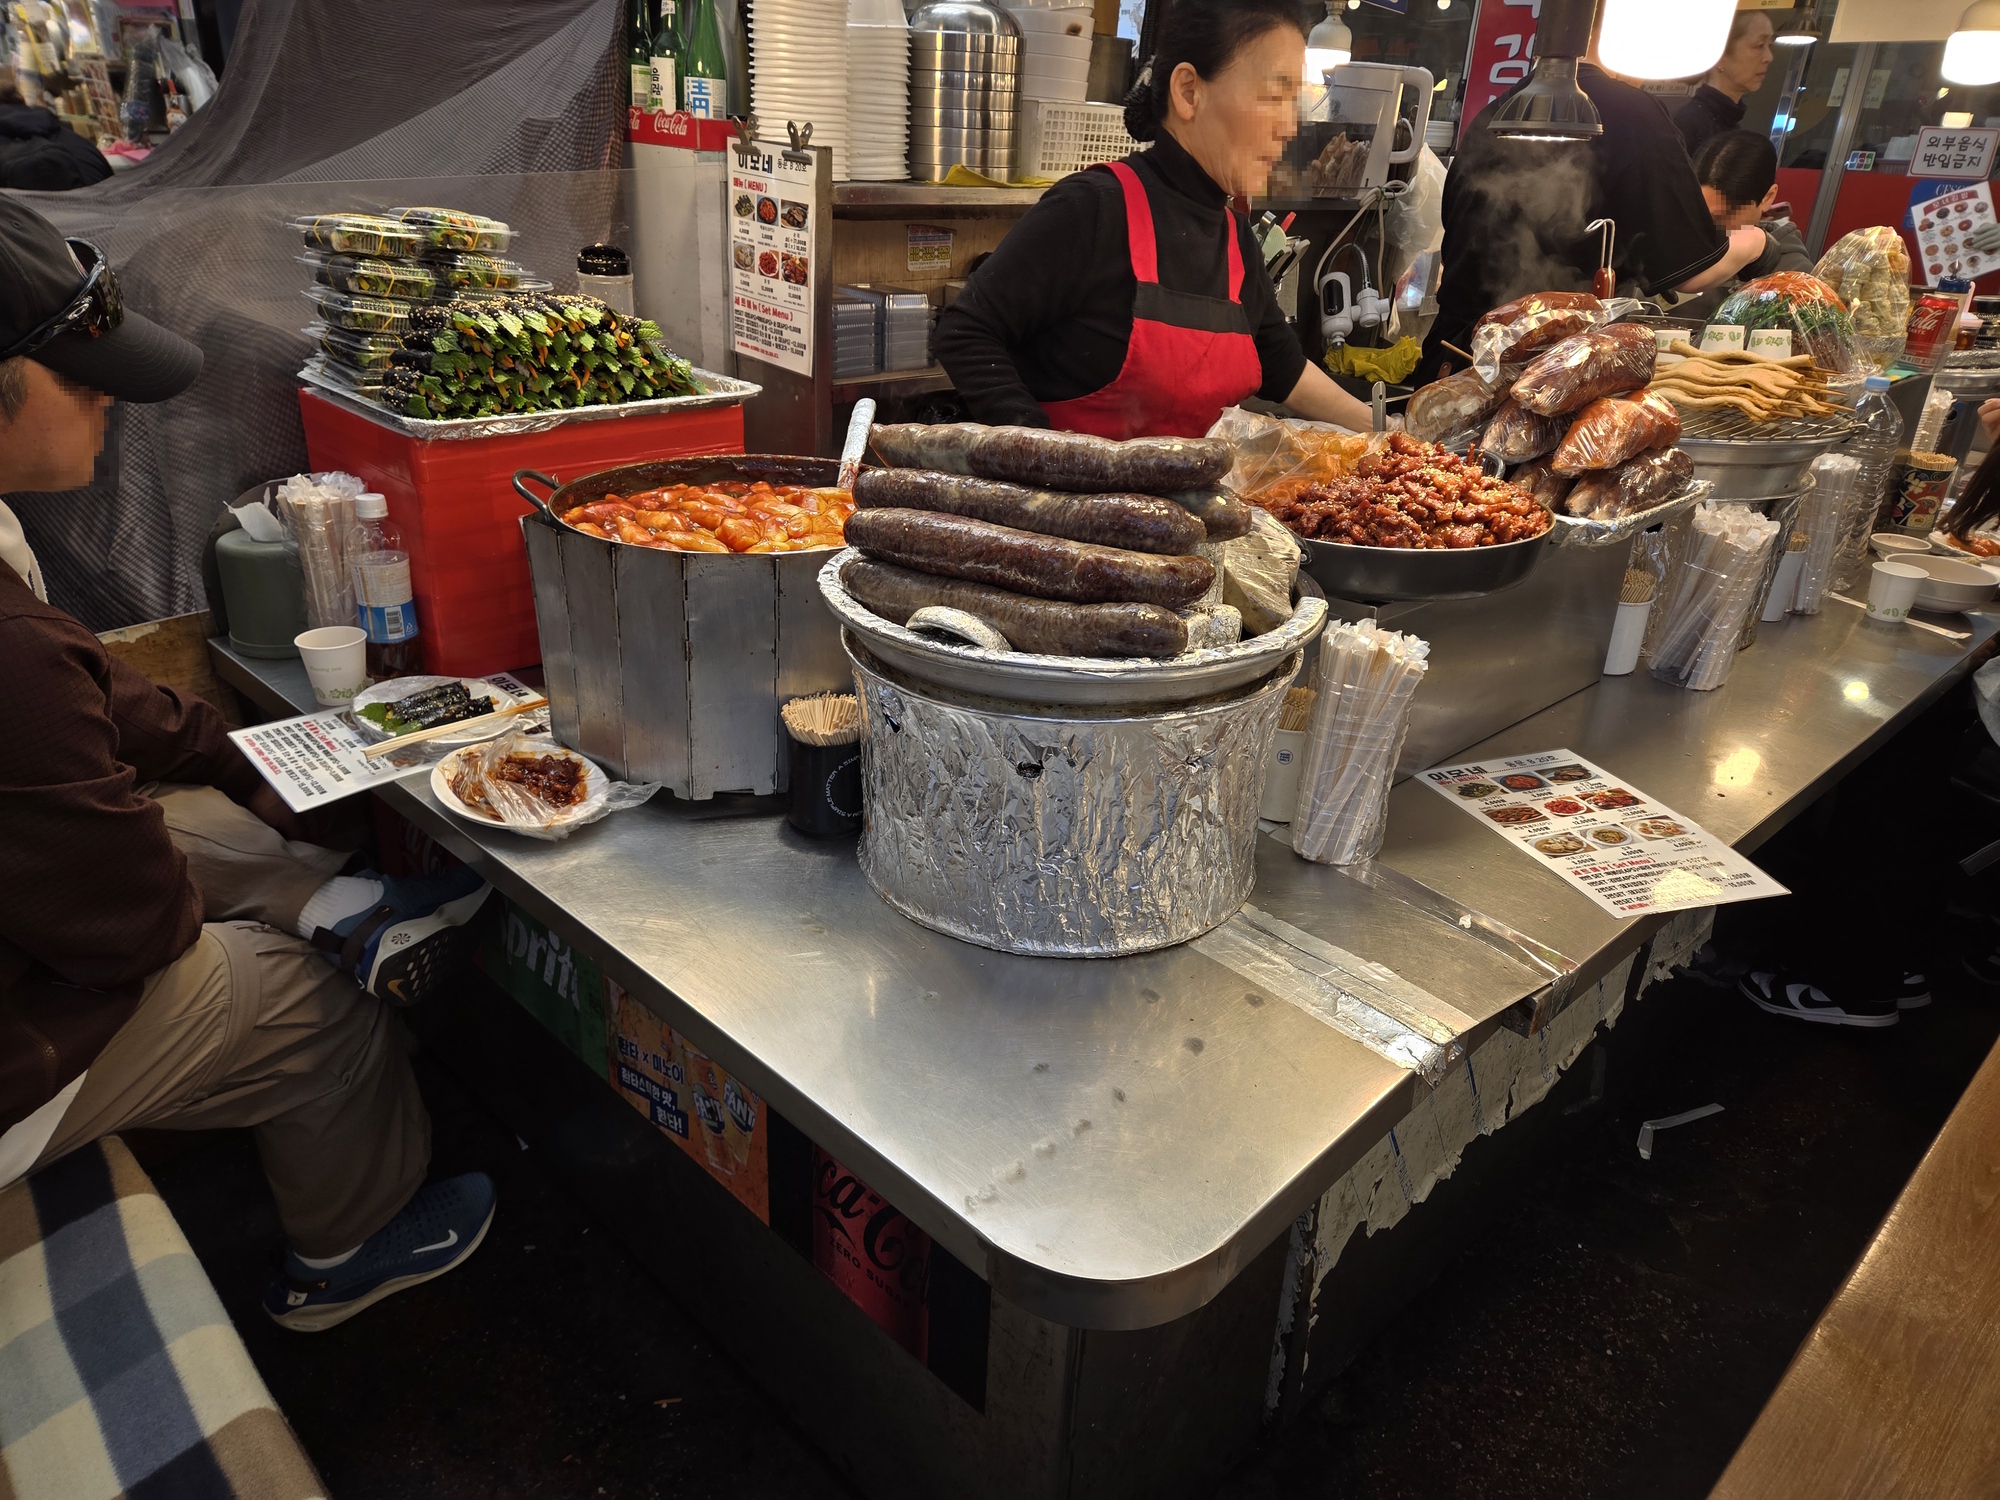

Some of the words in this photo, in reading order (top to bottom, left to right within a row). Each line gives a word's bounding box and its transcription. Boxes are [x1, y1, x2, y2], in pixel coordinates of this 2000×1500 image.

[1926, 135, 1988, 152] 외부음식
[1923, 154, 1982, 169] 반입금지
[825, 769, 838, 797] MATTER
[1427, 765, 1488, 781] 이모네
[652, 1053, 686, 1086] 미노이
[661, 1089, 677, 1112] 맛,
[692, 1092, 725, 1122] FANT
[723, 1081, 756, 1128] FANT
[829, 1237, 861, 1270] ZERO
